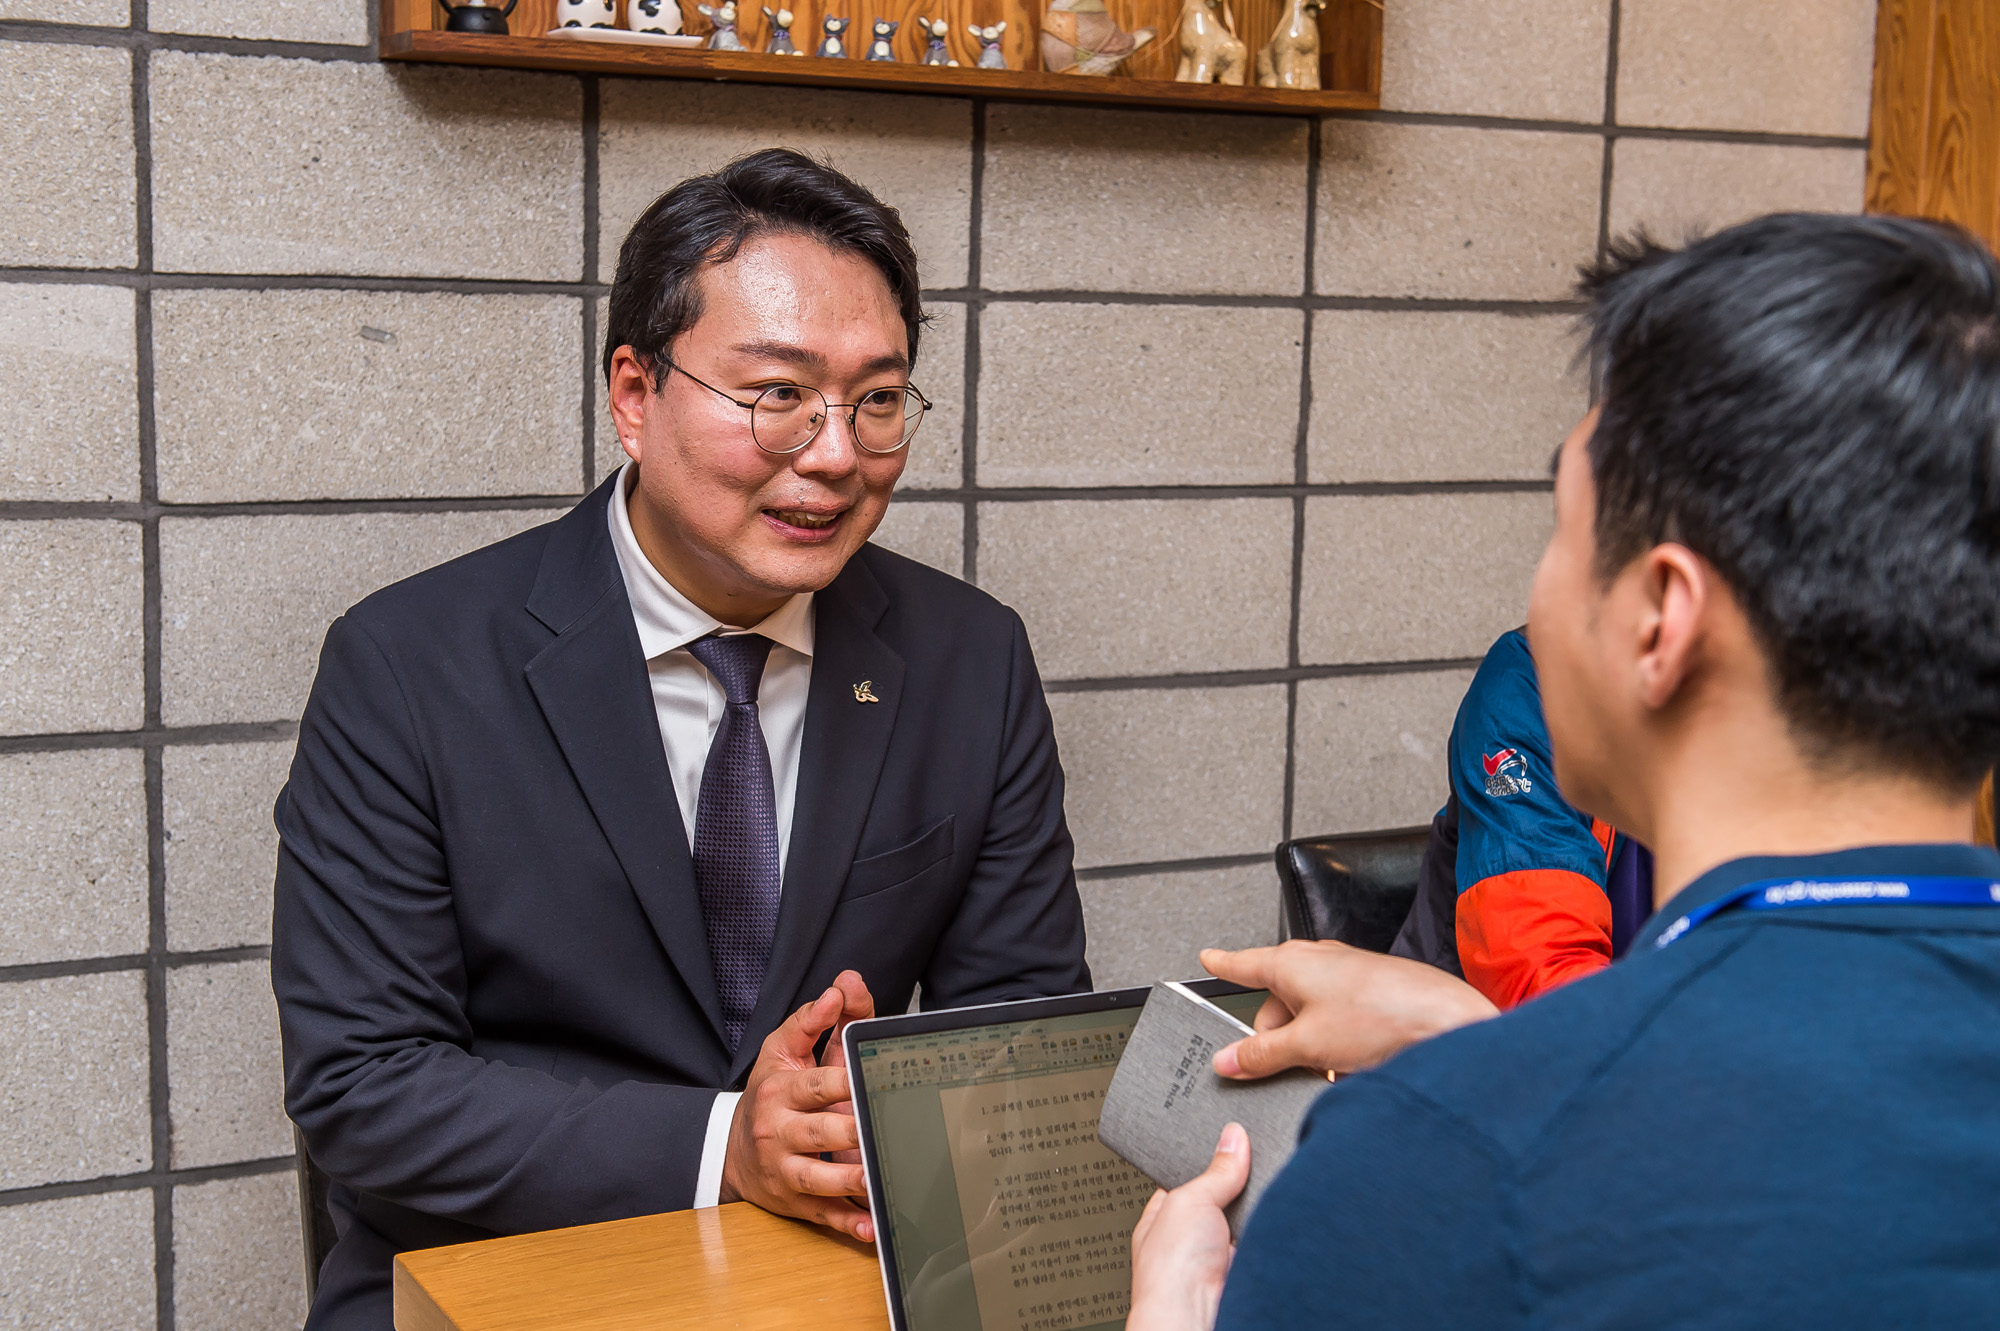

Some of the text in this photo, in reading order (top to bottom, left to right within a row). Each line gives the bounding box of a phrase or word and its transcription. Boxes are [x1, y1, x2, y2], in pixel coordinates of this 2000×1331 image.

[1024, 1169, 1051, 1181] 2021년
[1054, 1165, 1078, 1177] 이준석
[1092, 1159, 1116, 1170] 대표가
[1015, 1214, 1046, 1227] 기대하는
[1049, 1208, 1080, 1221] 목소리도
[1060, 1267, 1084, 1279] 이유는
